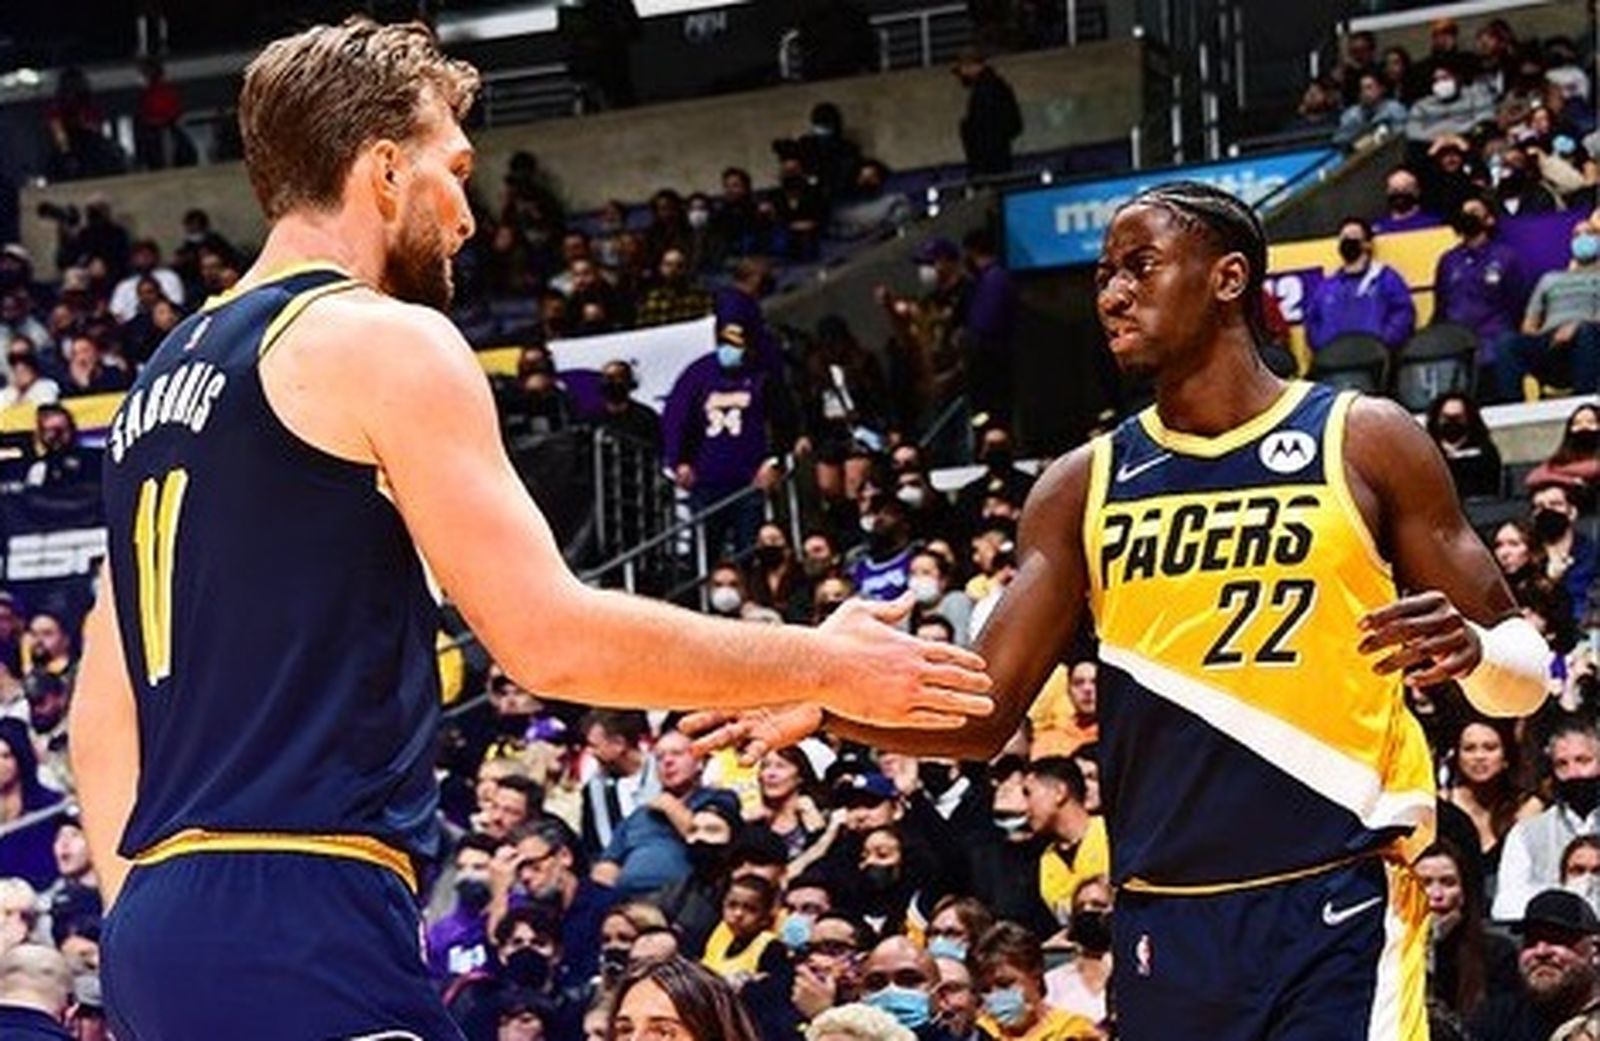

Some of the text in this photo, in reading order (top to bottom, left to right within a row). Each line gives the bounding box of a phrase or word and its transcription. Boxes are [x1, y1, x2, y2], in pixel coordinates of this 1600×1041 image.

[110, 361, 226, 463] SABONIS
[7, 526, 109, 581] ESP
[133, 467, 190, 687] 11
[1101, 495, 1321, 590] PACERS
[1202, 578, 1318, 670] 22
